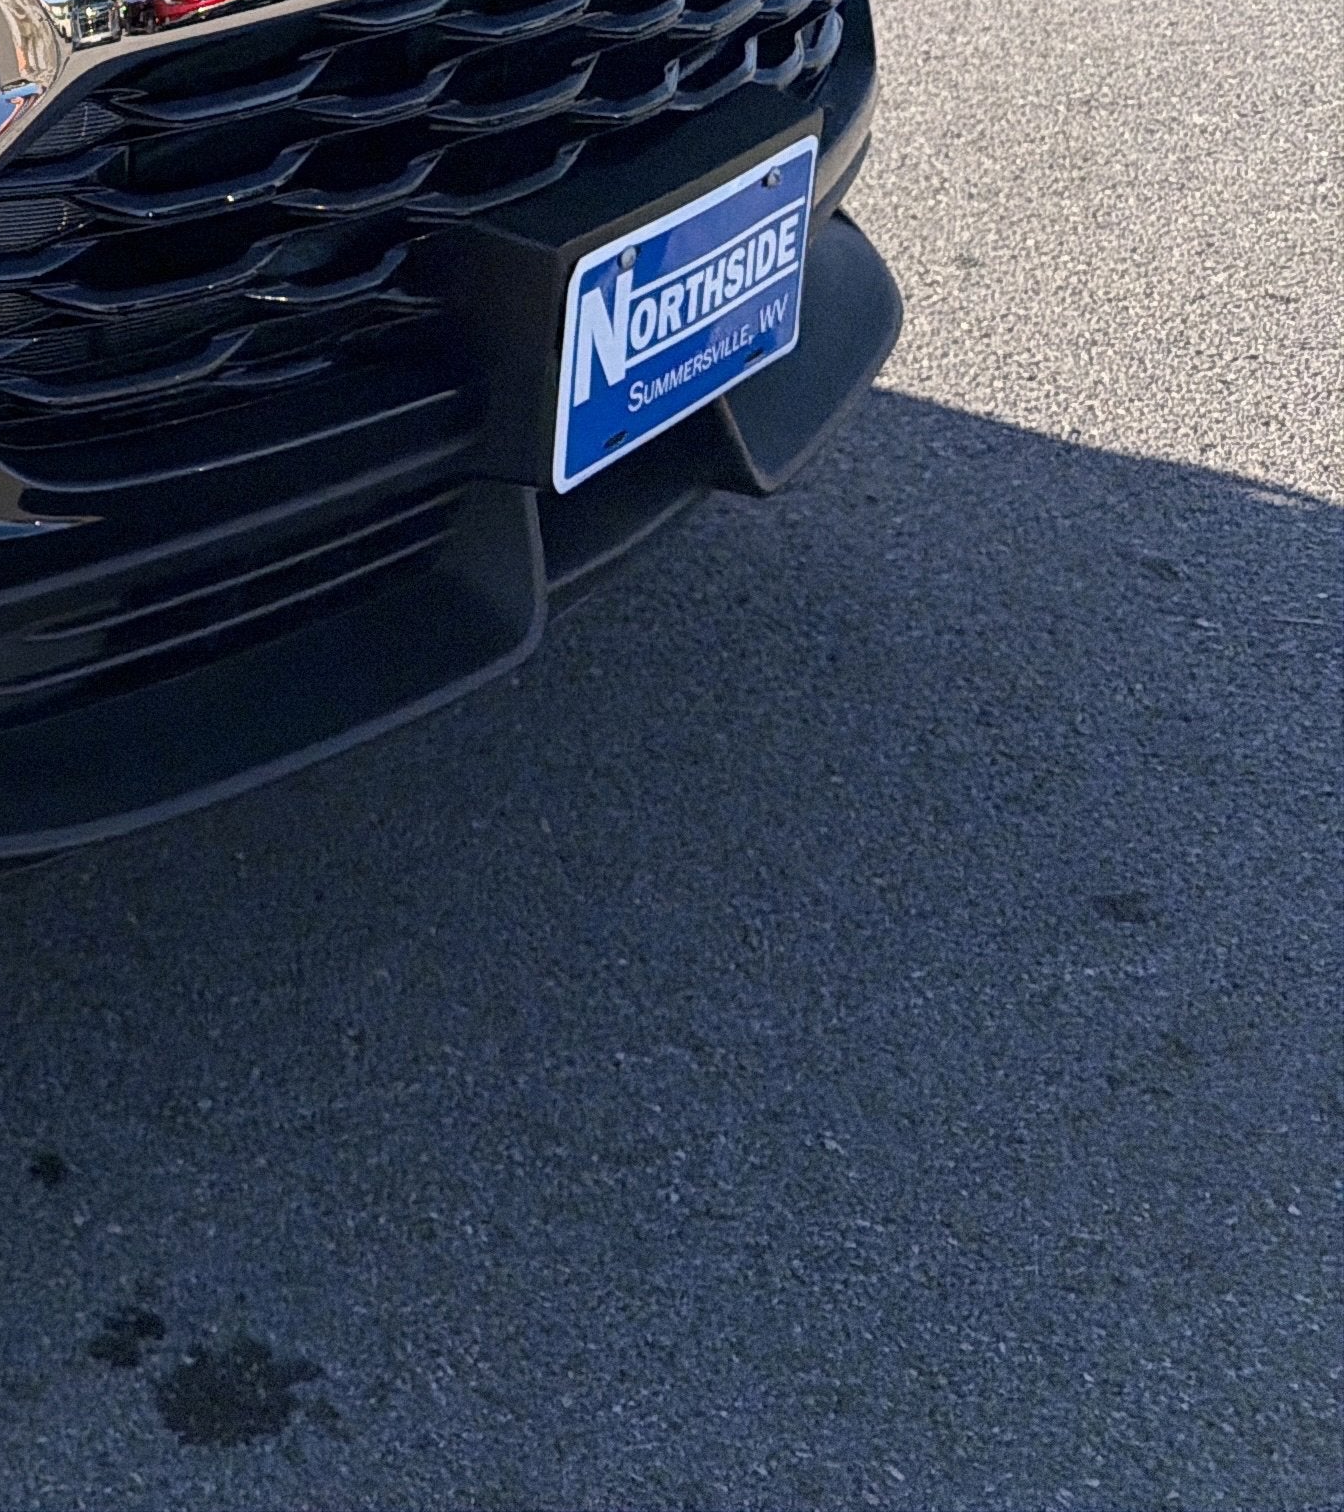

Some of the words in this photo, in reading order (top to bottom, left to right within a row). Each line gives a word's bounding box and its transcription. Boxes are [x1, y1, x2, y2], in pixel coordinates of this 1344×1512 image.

[573, 212, 800, 408] NORTHSIDE
[627, 323, 754, 413] SUMMERSVILLE,
[758, 292, 789, 335] WV
